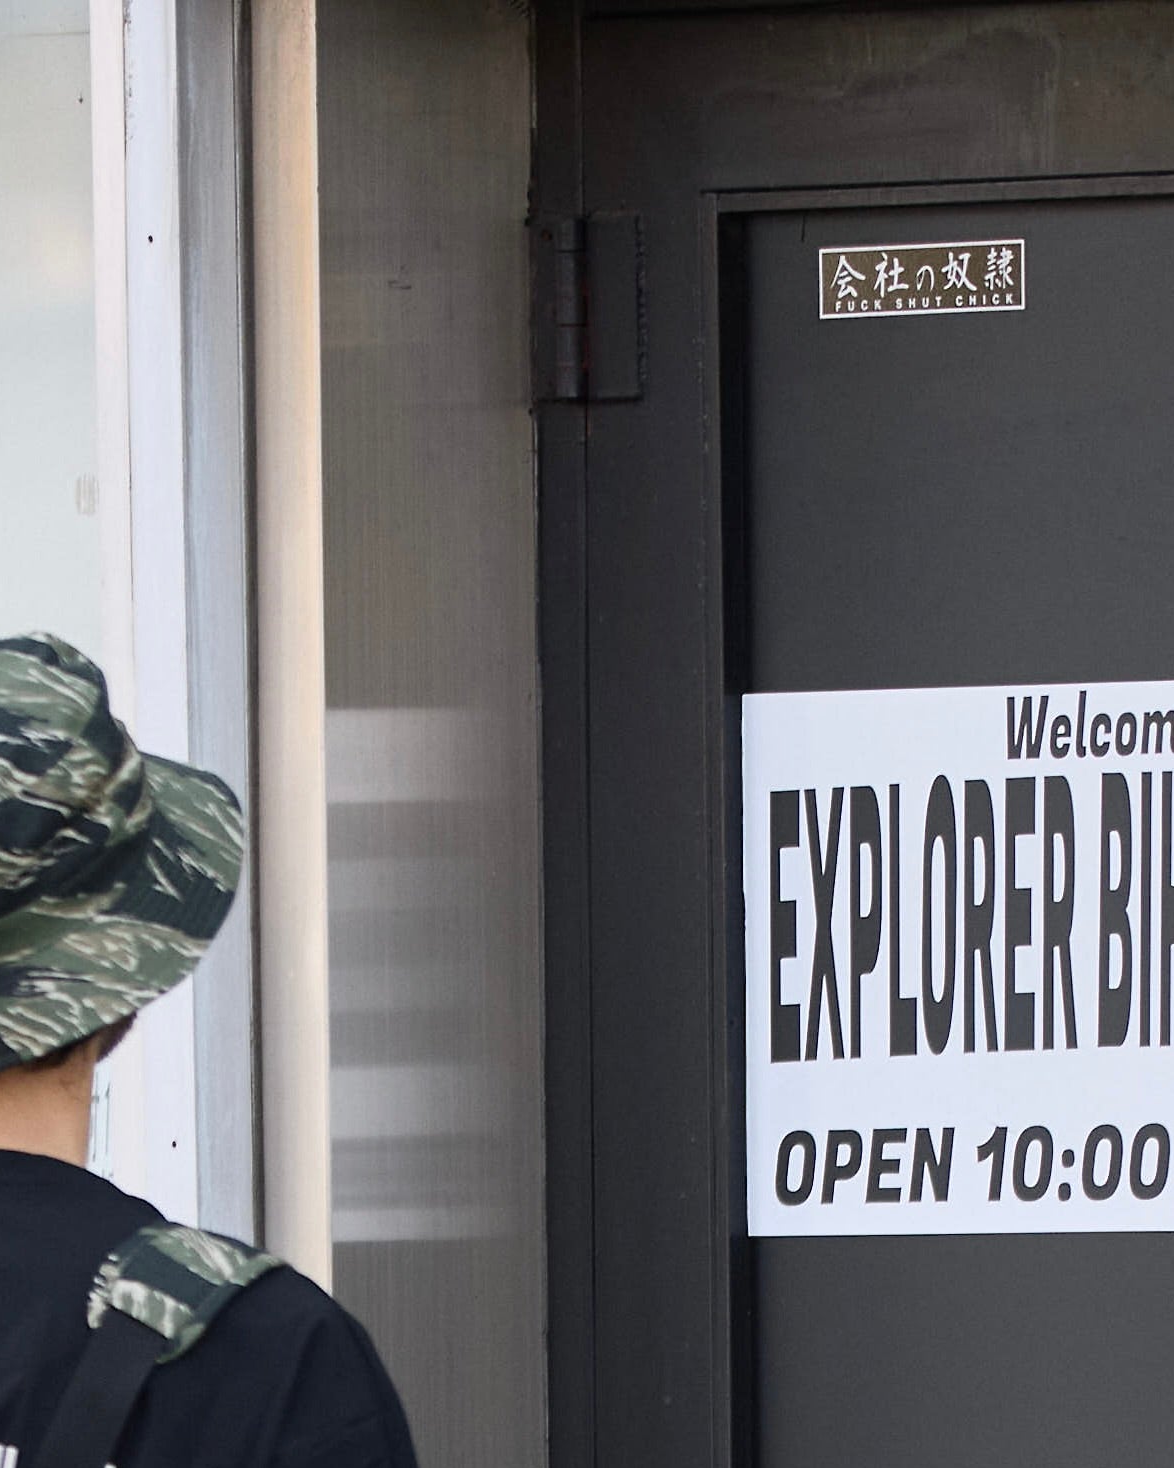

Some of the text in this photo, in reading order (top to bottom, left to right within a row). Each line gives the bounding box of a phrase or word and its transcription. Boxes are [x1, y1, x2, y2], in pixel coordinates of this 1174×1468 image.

[831, 247, 1014, 299] 会社の奴隷
[835, 293, 1014, 312] FUCK SHUT CHICK
[1006, 691, 1174, 760] Welcom
[770, 775, 1078, 1063] EXPLORER
[775, 1122, 1171, 1206] OPEN 10:00
